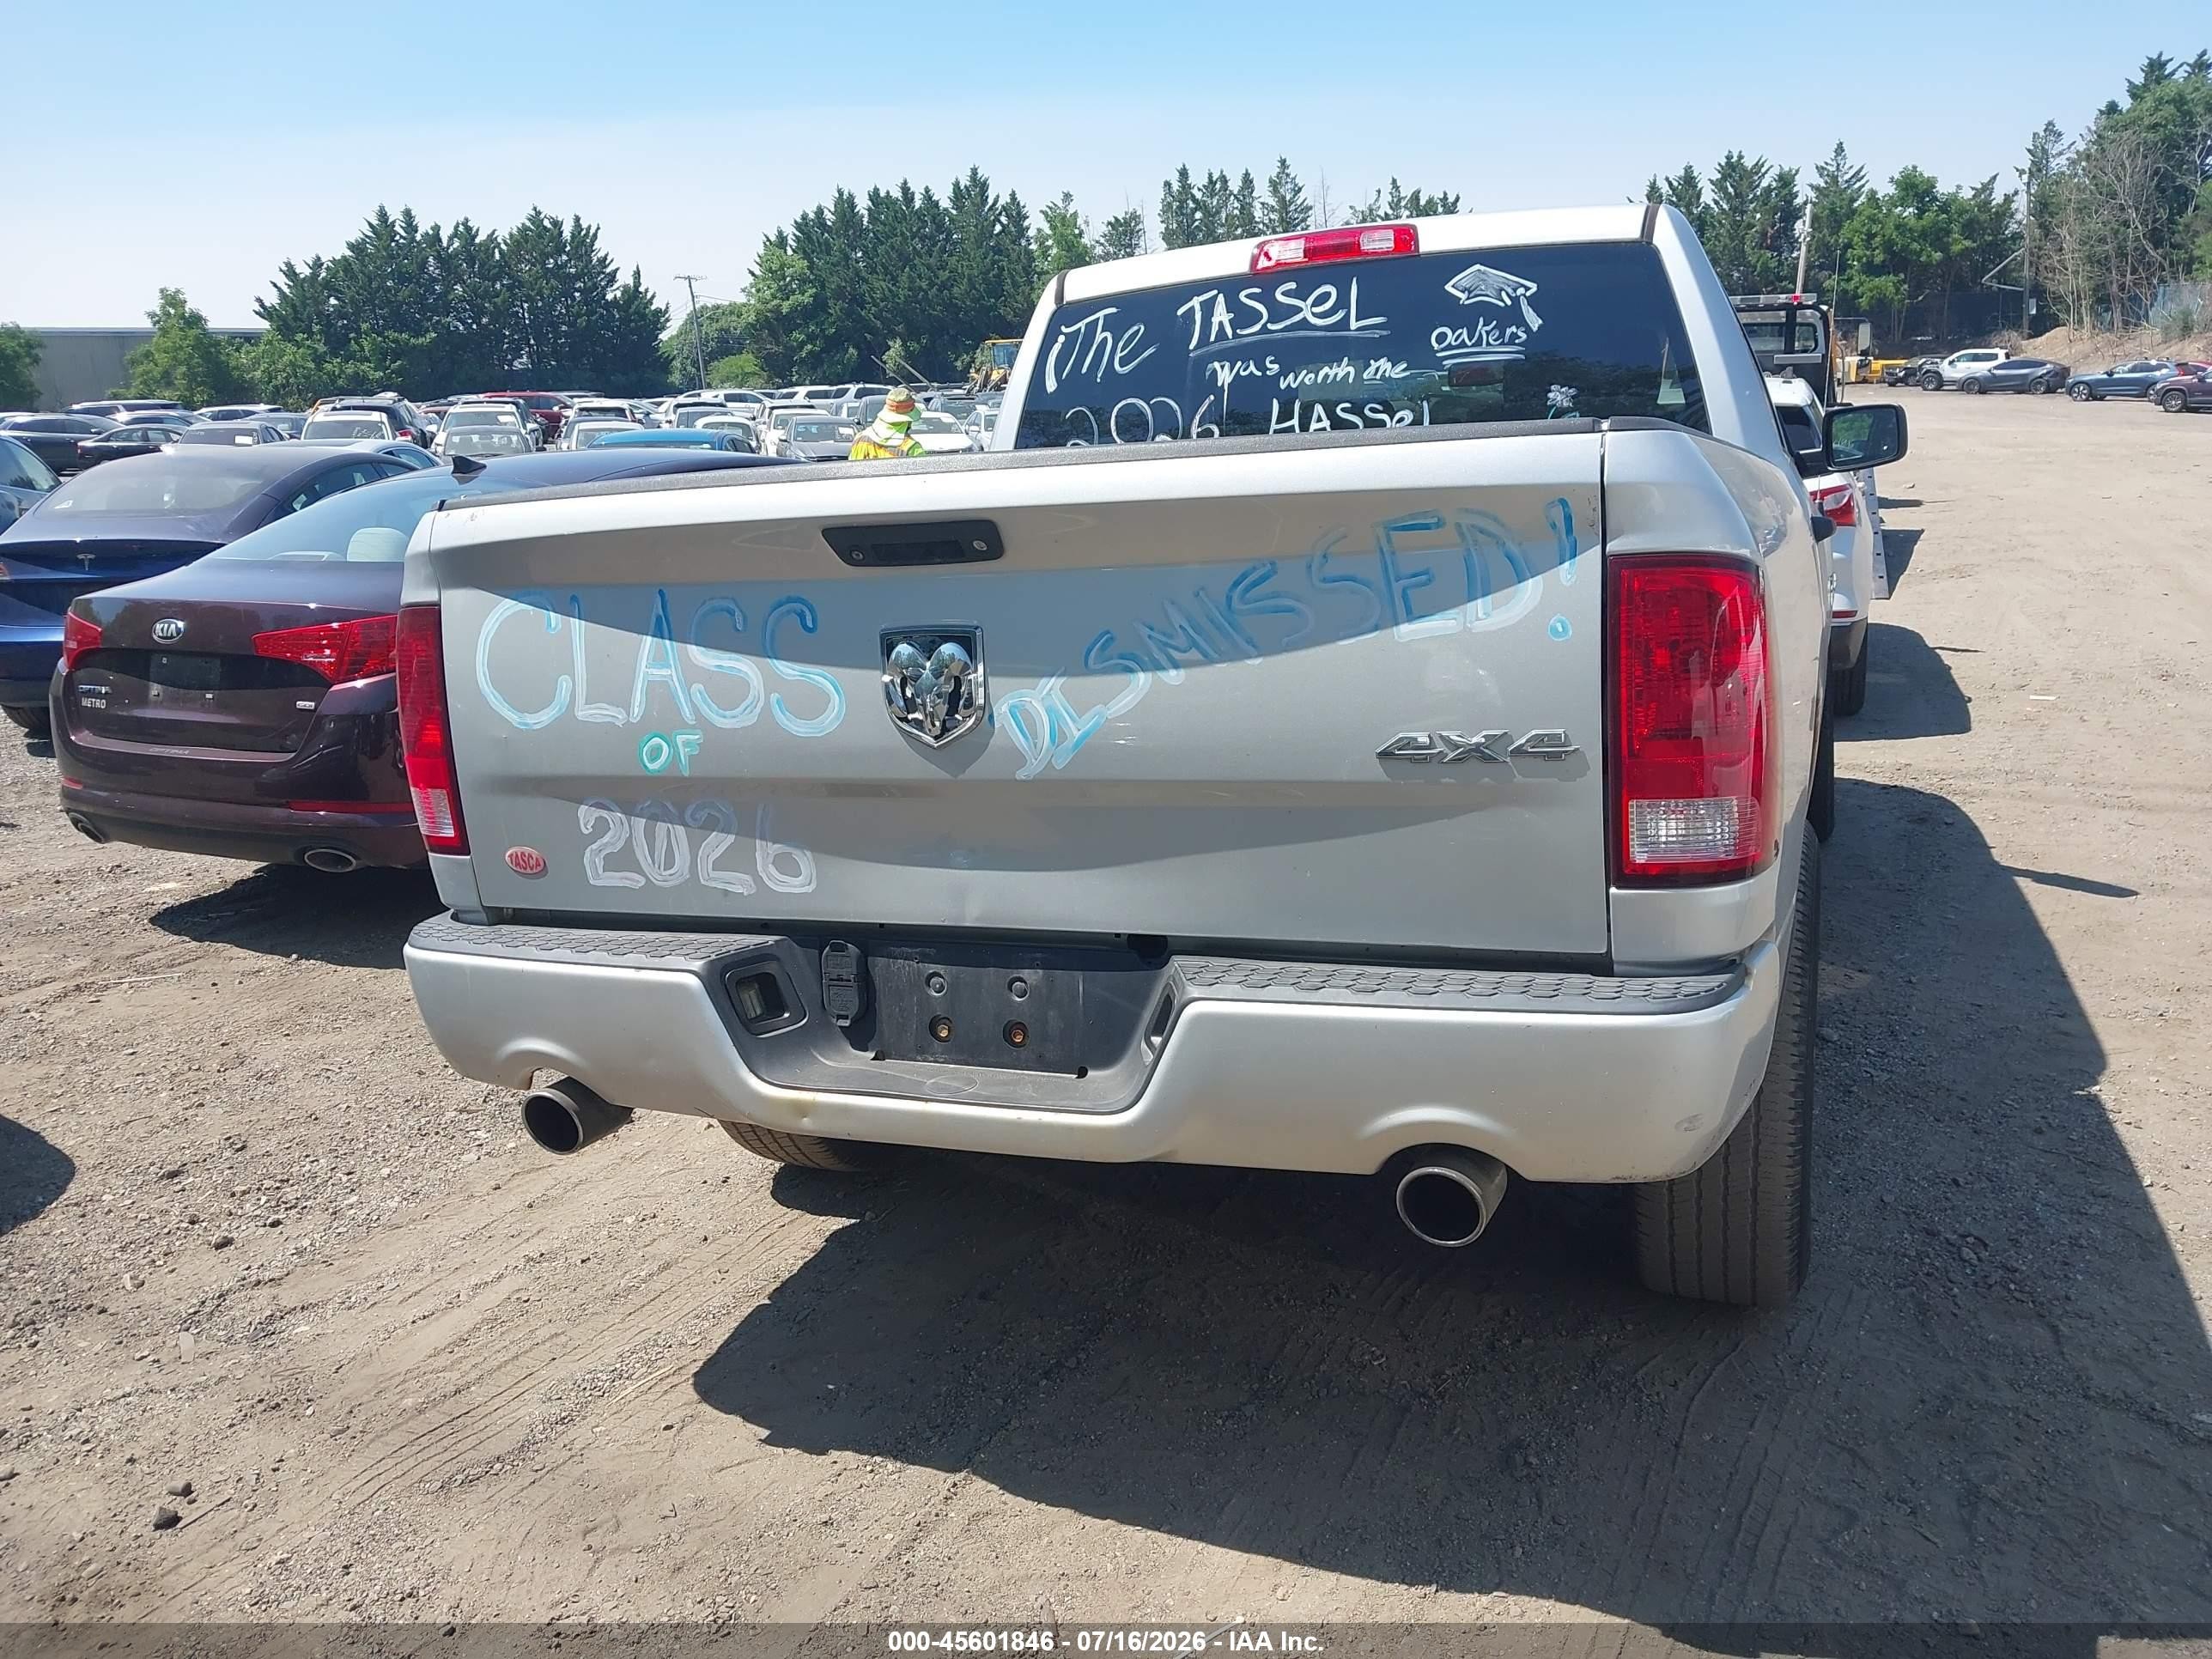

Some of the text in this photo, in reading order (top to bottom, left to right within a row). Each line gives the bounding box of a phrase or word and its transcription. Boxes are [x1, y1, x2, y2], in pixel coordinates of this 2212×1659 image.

[1206, 355, 1411, 390] was worth the
[1065, 394, 1220, 447] 2026
[155, 623, 177, 637] KIA
[476, 588, 846, 738] CLASS
[82, 696, 106, 708] METRO
[638, 729, 703, 776] OF
[507, 851, 542, 872] TASCA
[577, 797, 817, 896] 2026
